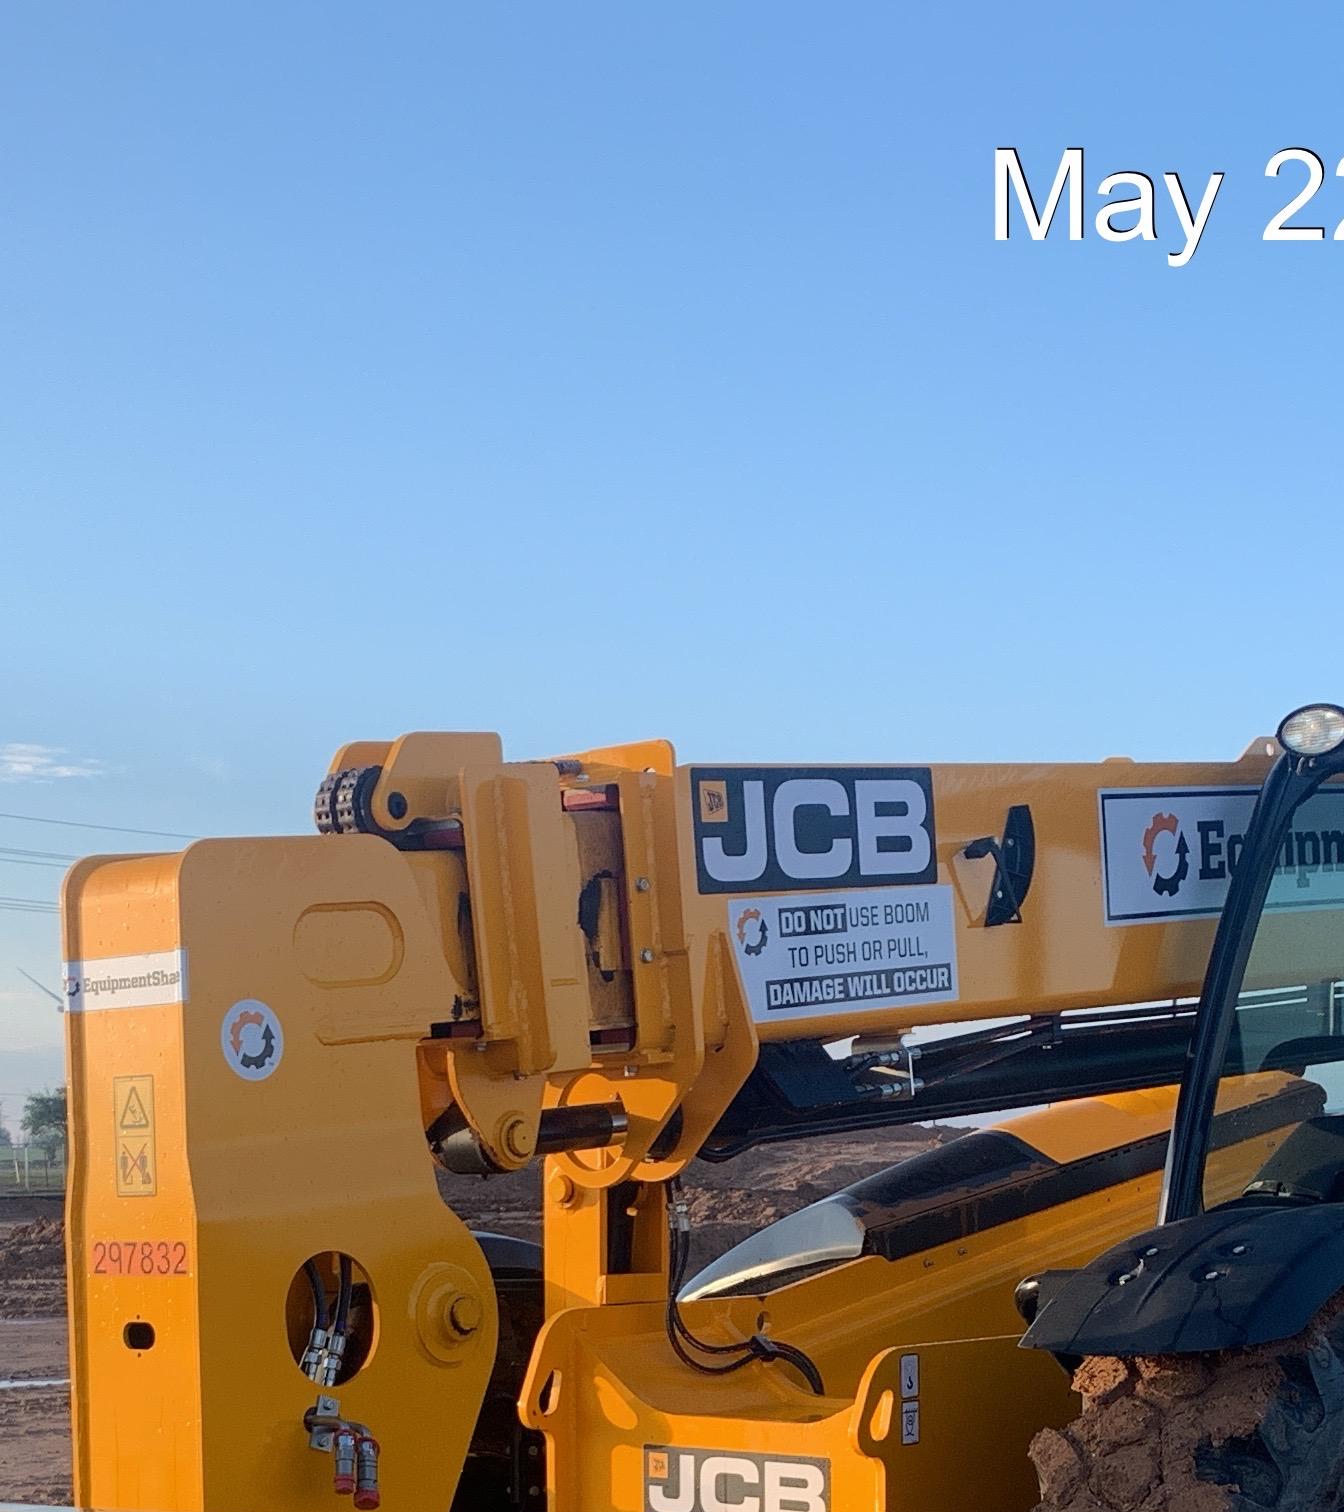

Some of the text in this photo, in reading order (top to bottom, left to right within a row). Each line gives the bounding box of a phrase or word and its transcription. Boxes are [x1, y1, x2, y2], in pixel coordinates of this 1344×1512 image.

[702, 778, 931, 882] JCB
[781, 902, 930, 934] DO NOT USE BOOM
[788, 936, 929, 968] TO PUSH OR PULL,
[769, 967, 950, 1007] DAMAGE WILL OCCUR
[93, 1241, 187, 1274] 297832
